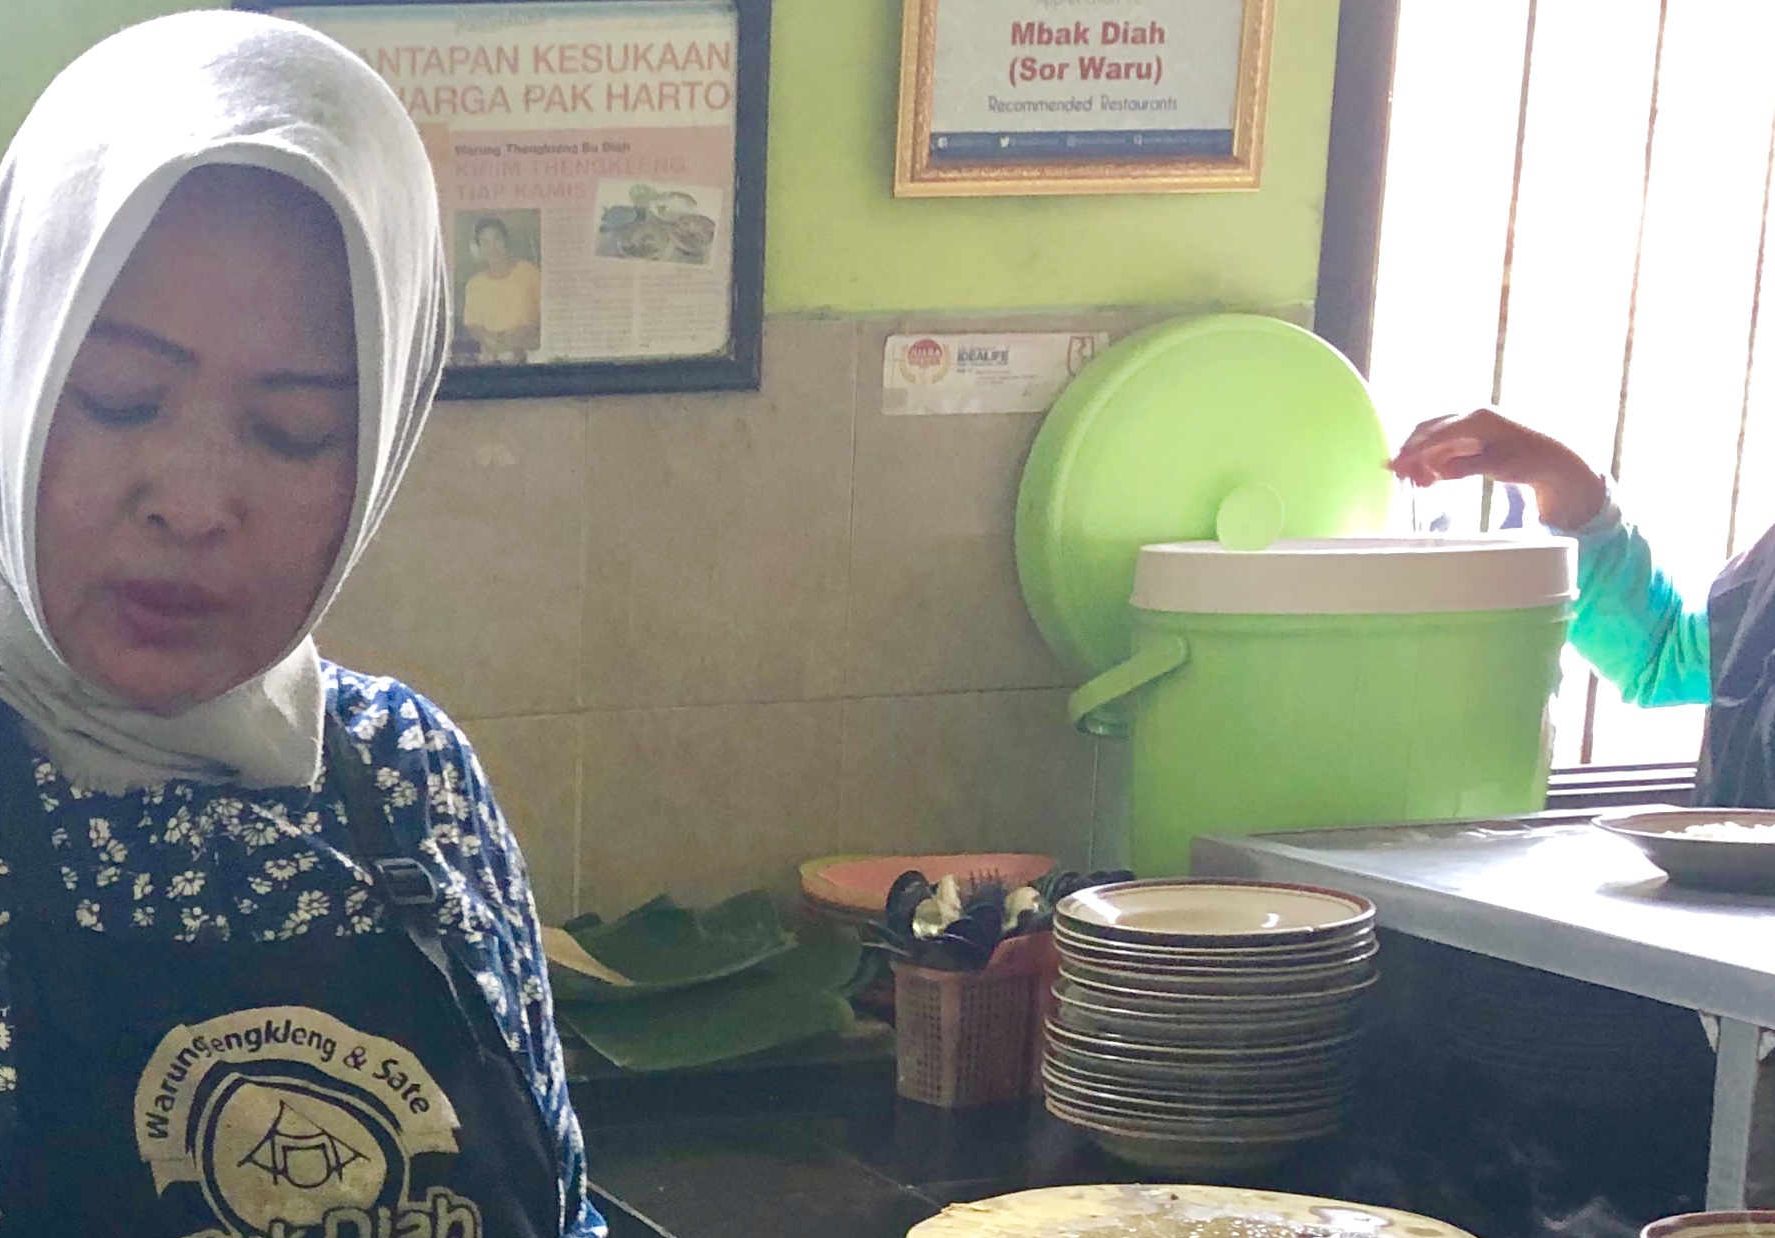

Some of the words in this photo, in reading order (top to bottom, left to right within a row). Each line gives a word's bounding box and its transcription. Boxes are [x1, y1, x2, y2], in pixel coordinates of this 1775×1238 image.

[1011, 21, 1089, 46] Mbak
[1101, 21, 1165, 45] Diah
[533, 41, 730, 74] KESUKAAN
[1009, 57, 1070, 87] (Sor
[1079, 55, 1163, 85] Waru)
[398, 85, 512, 115] ARGA
[524, 83, 594, 113] PAK
[605, 80, 731, 112] HARTO
[988, 95, 1093, 113] Recommended
[1100, 94, 1178, 111] Restaurants
[343, 1047, 368, 1070] &
[373, 1058, 430, 1115] Sate
